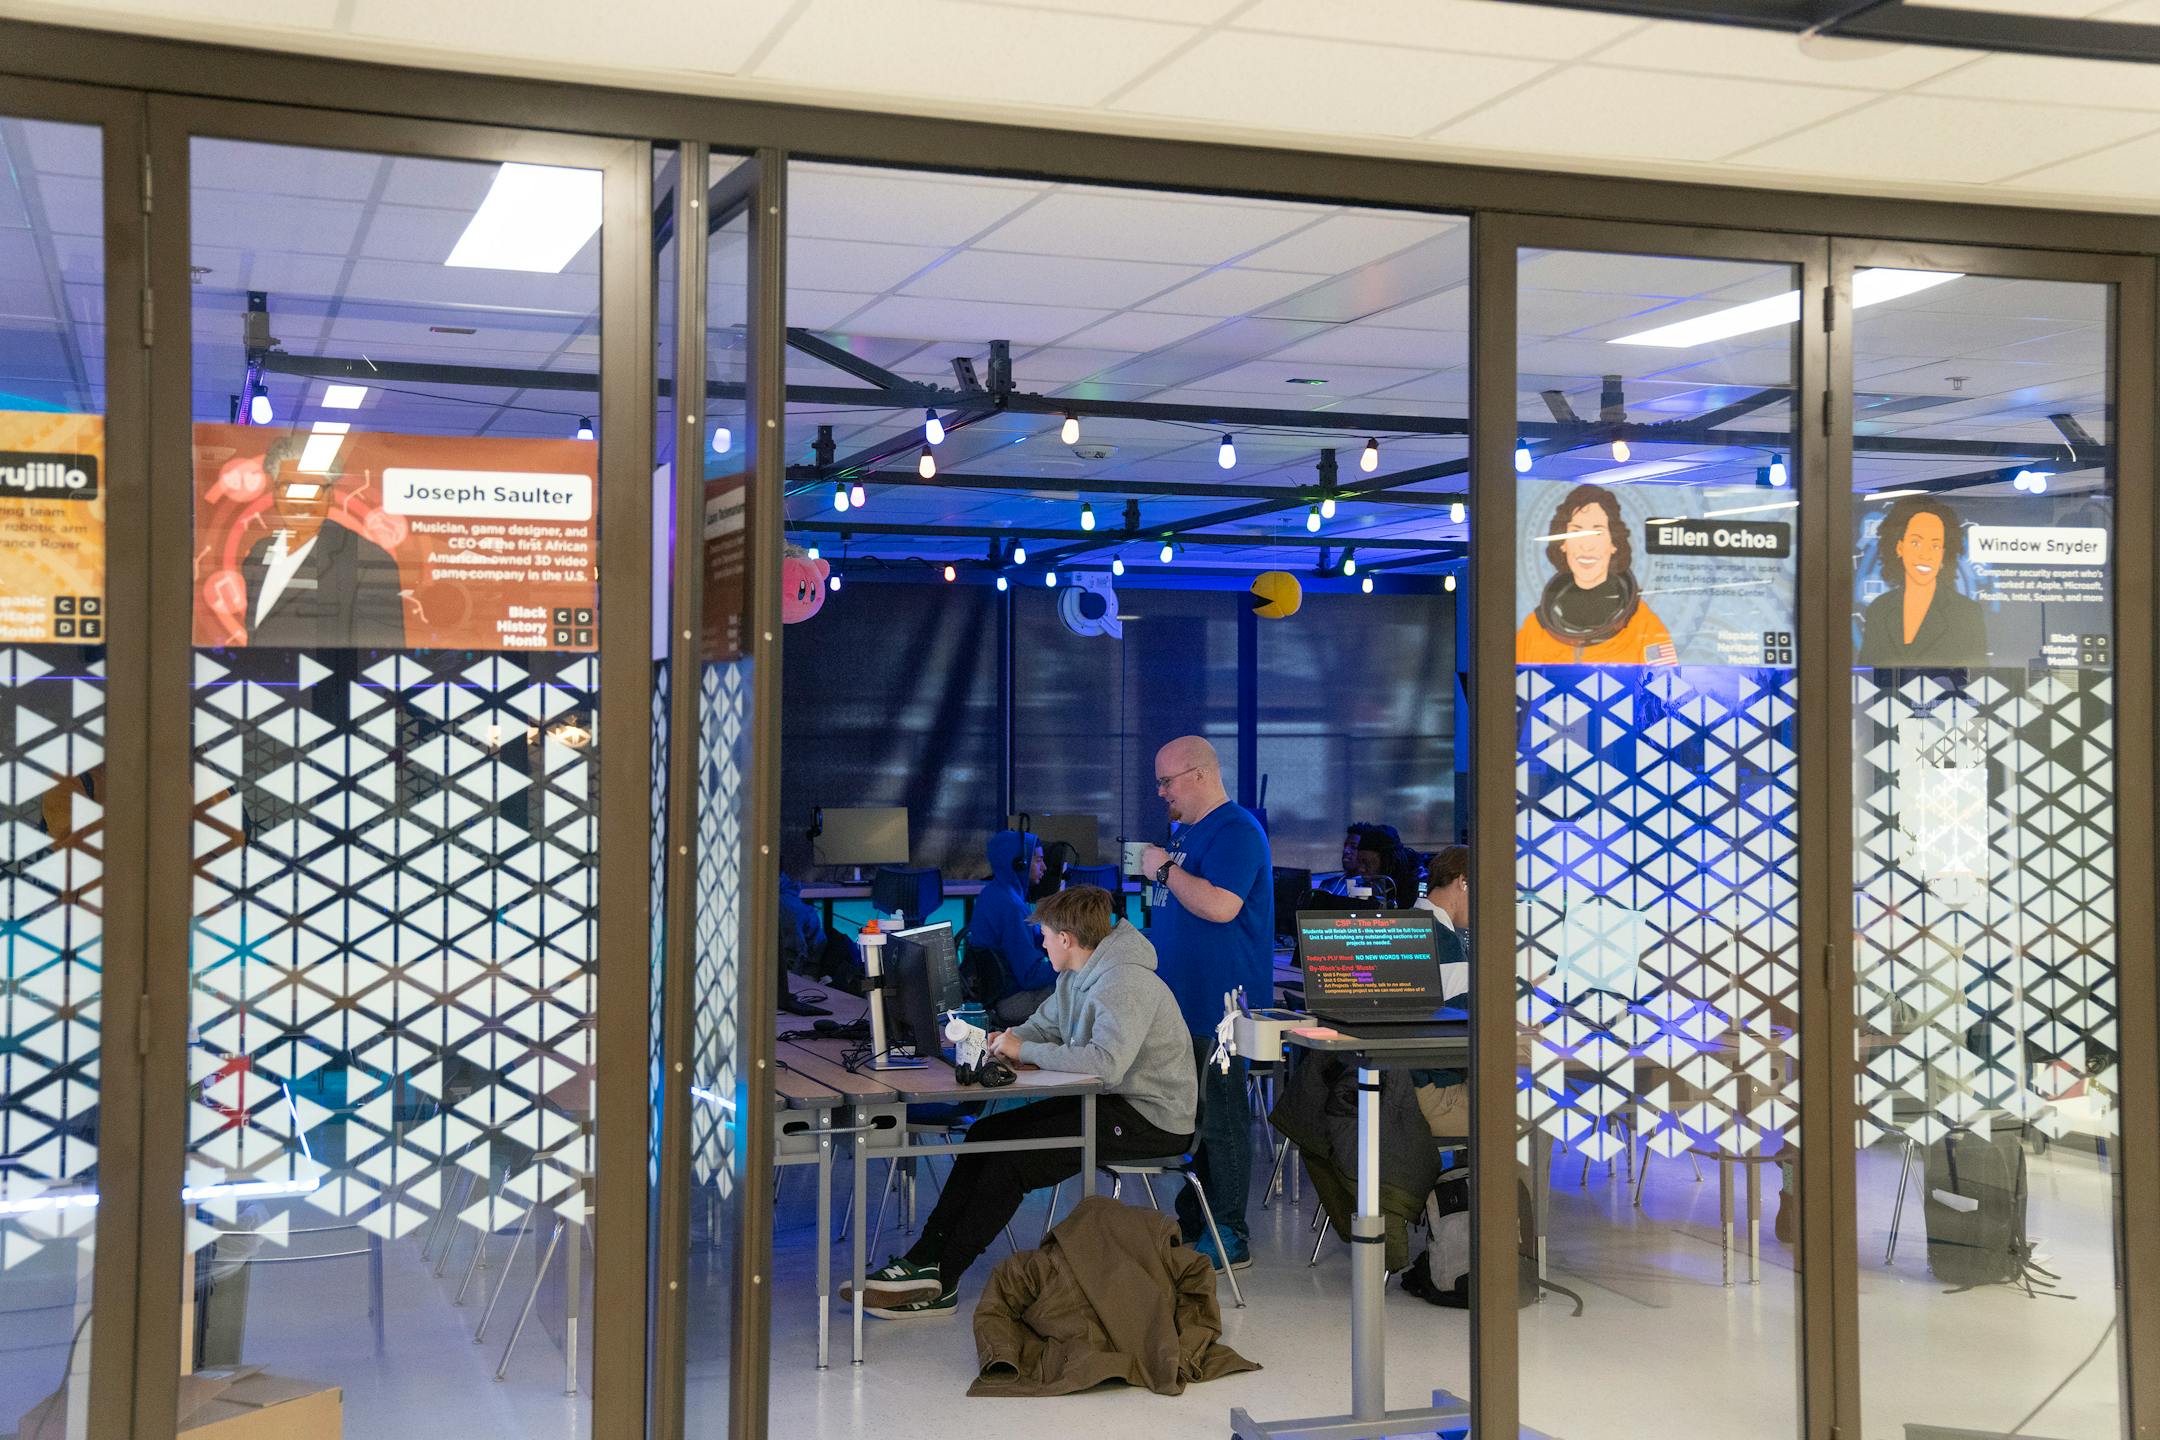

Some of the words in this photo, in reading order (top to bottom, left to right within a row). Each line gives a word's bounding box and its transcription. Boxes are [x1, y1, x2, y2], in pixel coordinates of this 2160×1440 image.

[403, 484, 485, 504] Joseph
[494, 487, 573, 504] Saulter
[31, 508, 65, 517] team
[5, 522, 55, 533] robotic
[61, 525, 88, 533] arm
[411, 521, 468, 535] Musician,
[471, 525, 506, 536] game
[508, 524, 563, 538] designer,
[564, 526, 588, 538] and
[41, 538, 80, 549] Rover
[448, 537, 477, 549] CEO
[517, 539, 542, 551] first
[544, 540, 588, 552] African
[1658, 527, 1709, 547] Ellen
[1713, 529, 1777, 549] Ochoa
[1978, 538, 2041, 552] Window
[2047, 540, 2098, 554] Snyder
[534, 555, 552, 566] 3D
[554, 555, 588, 567] video
[432, 569, 467, 580] game
[468, 570, 525, 582] company
[528, 569, 540, 580] in
[541, 570, 562, 581] the
[564, 570, 588, 581] U.S.
[509, 606, 547, 619] Black
[496, 621, 547, 634] History
[503, 634, 547, 647] Month
[2050, 634, 2077, 643] Black
[2042, 645, 2078, 656] History
[2047, 657, 2079, 666] Month
[1358, 919, 1371, 927] The
[884, 1265, 906, 1279] N
